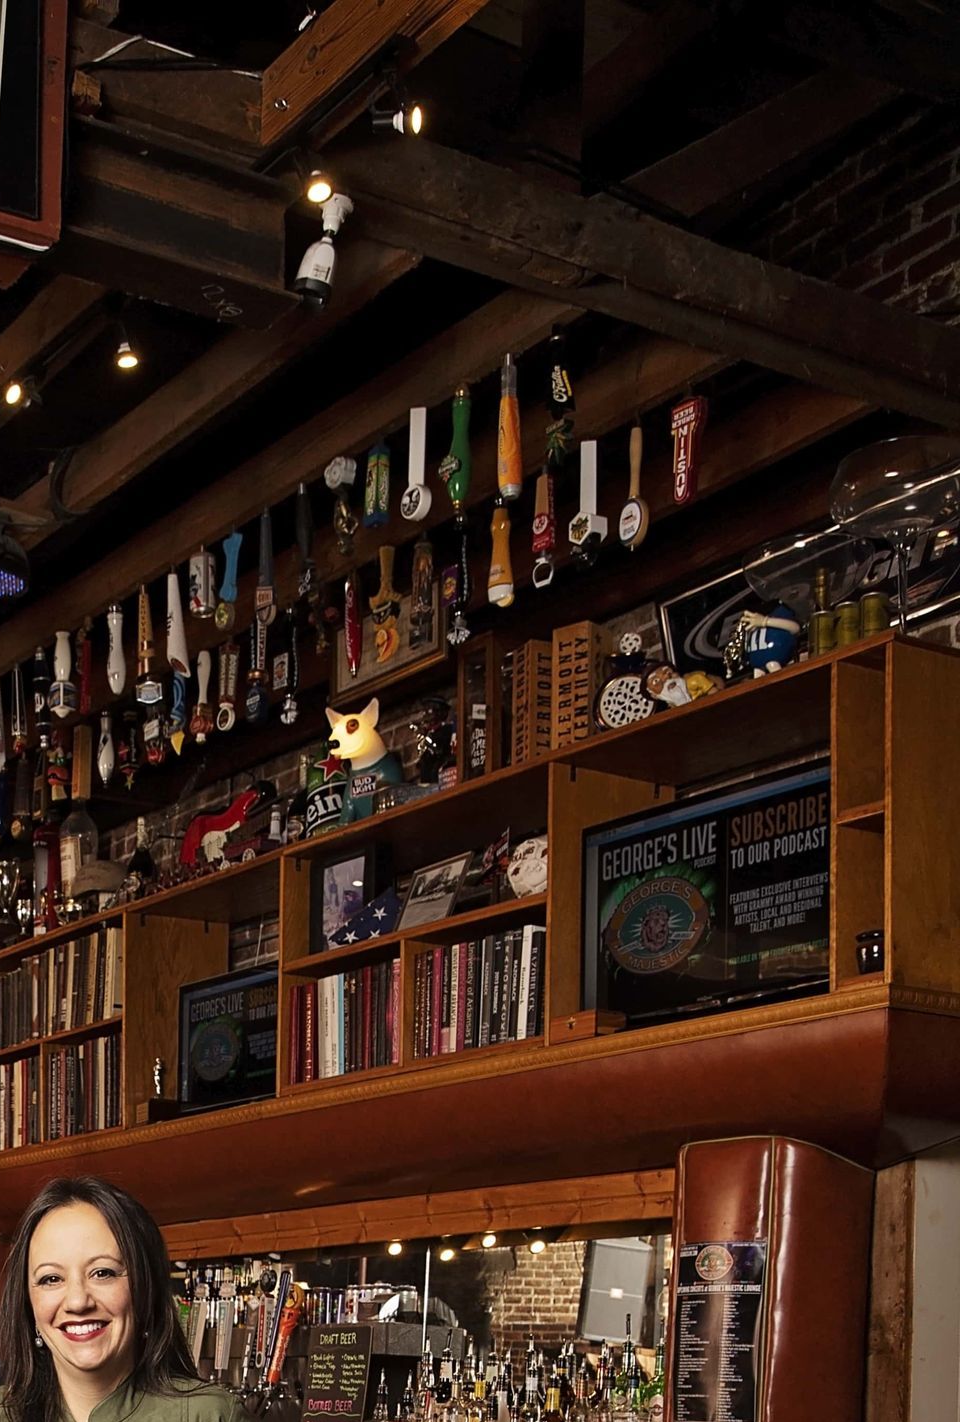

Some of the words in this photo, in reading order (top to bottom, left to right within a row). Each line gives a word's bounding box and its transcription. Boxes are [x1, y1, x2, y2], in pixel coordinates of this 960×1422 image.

[676, 424, 688, 498] AUSTIN
[344, 591, 354, 659] Budweiser
[258, 625, 266, 668] NEWCASTL
[536, 653, 552, 756] LERMONT
[574, 637, 588, 740] ENTUCKY
[306, 794, 343, 823] ein
[730, 792, 828, 847] SUBSCRIBE
[602, 832, 678, 882] GEORGE'S
[682, 822, 718, 860] LIVE
[693, 854, 717, 869] PODCAST
[730, 848, 744, 870] TO
[748, 841, 770, 866] OUR
[774, 826, 827, 860] PODCAST
[730, 888, 760, 905] FEATURING
[760, 880, 791, 896] EXCLUSIVE
[792, 872, 828, 890] INTERVIEWS
[733, 902, 748, 915] WITH
[748, 896, 774, 913] GRAMMY
[775, 891, 796, 906] AWARD
[797, 884, 824, 900] WINNING
[734, 912, 759, 926] ARTISTS,
[760, 906, 778, 921] LOCAL
[780, 904, 792, 917] AND
[793, 897, 822, 914] REGIONAL
[749, 920, 772, 934] TALENT,
[773, 916, 786, 929] AND
[468, 942, 476, 986] University
[628, 947, 689, 970] MAJESTIC
[466, 987, 474, 996] of
[500, 945, 510, 1030] RAZORBACK
[528, 947, 538, 1012] RAZORBACK
[191, 996, 226, 1022] GEORGE'S
[227, 992, 244, 1014] LIVE
[464, 999, 474, 1038] Arkansas
[320, 1334, 339, 1345] DRAFT
[340, 1332, 357, 1345] BEER
[334, 1399, 353, 1412] BEER
